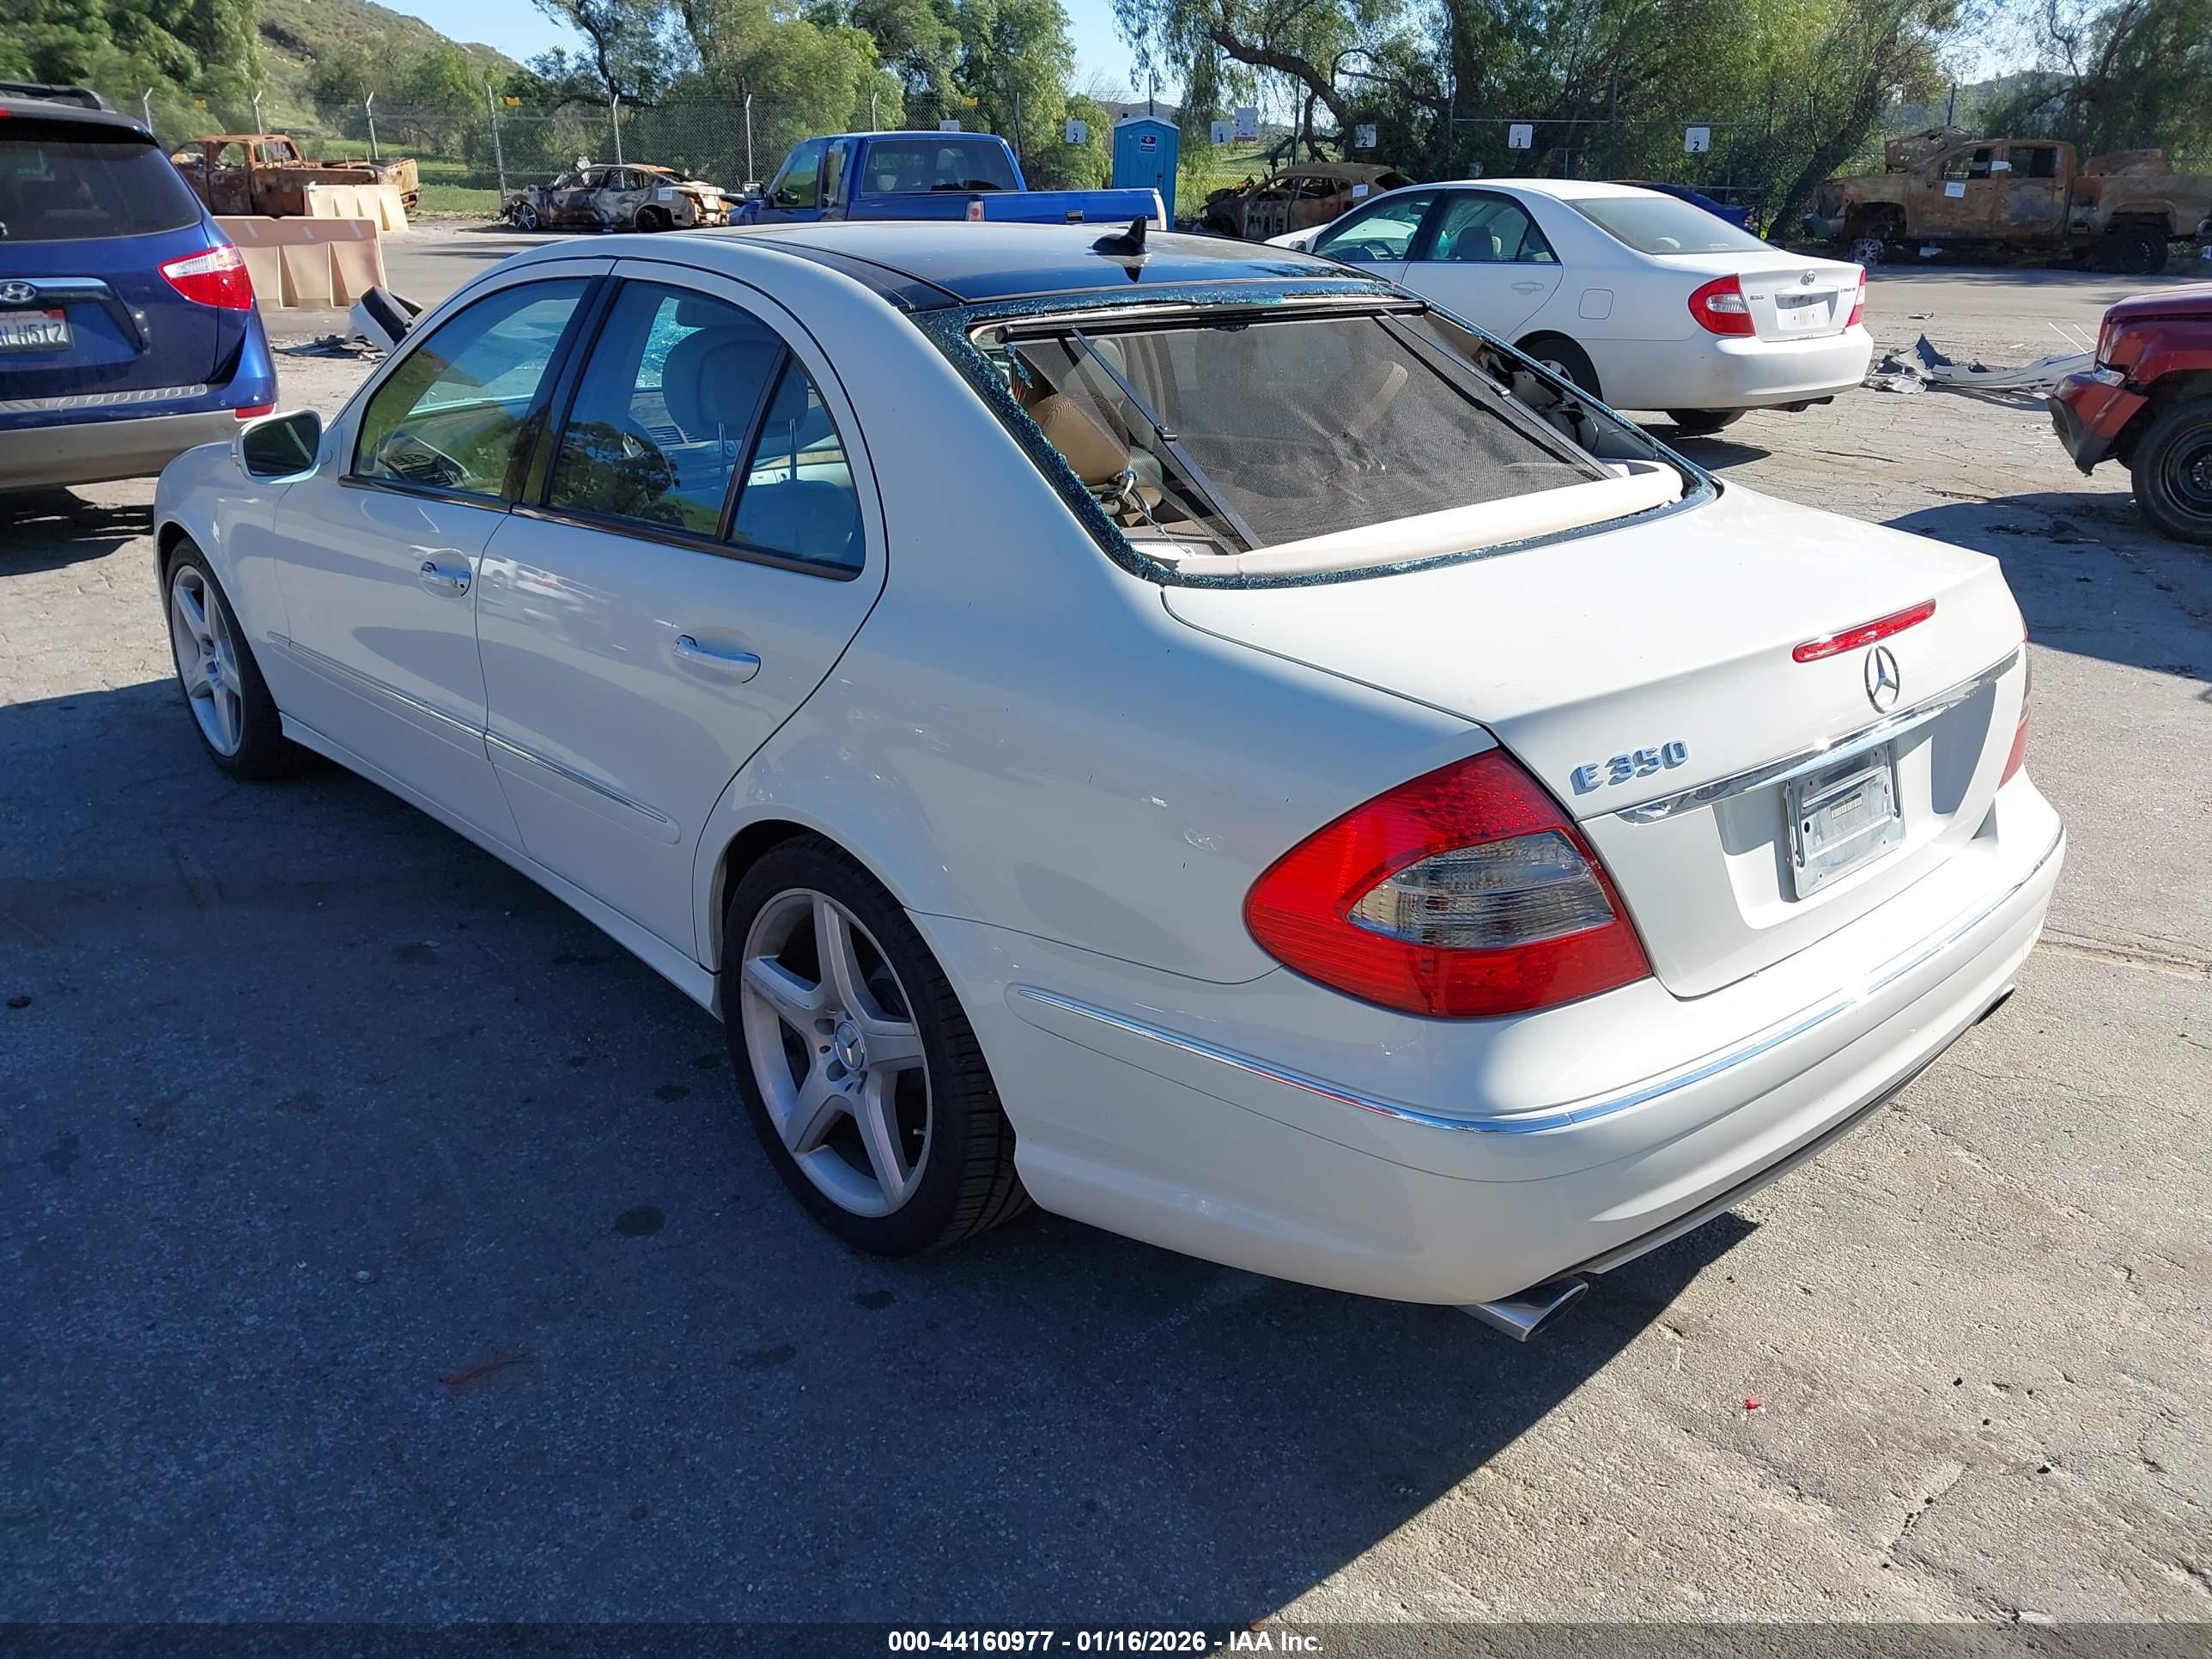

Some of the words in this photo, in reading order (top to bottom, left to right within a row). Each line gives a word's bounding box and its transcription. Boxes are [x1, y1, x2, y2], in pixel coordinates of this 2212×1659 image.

[1073, 132, 1079, 142] 2
[1361, 137, 1368, 147] 2
[1692, 140, 1700, 151] 2
